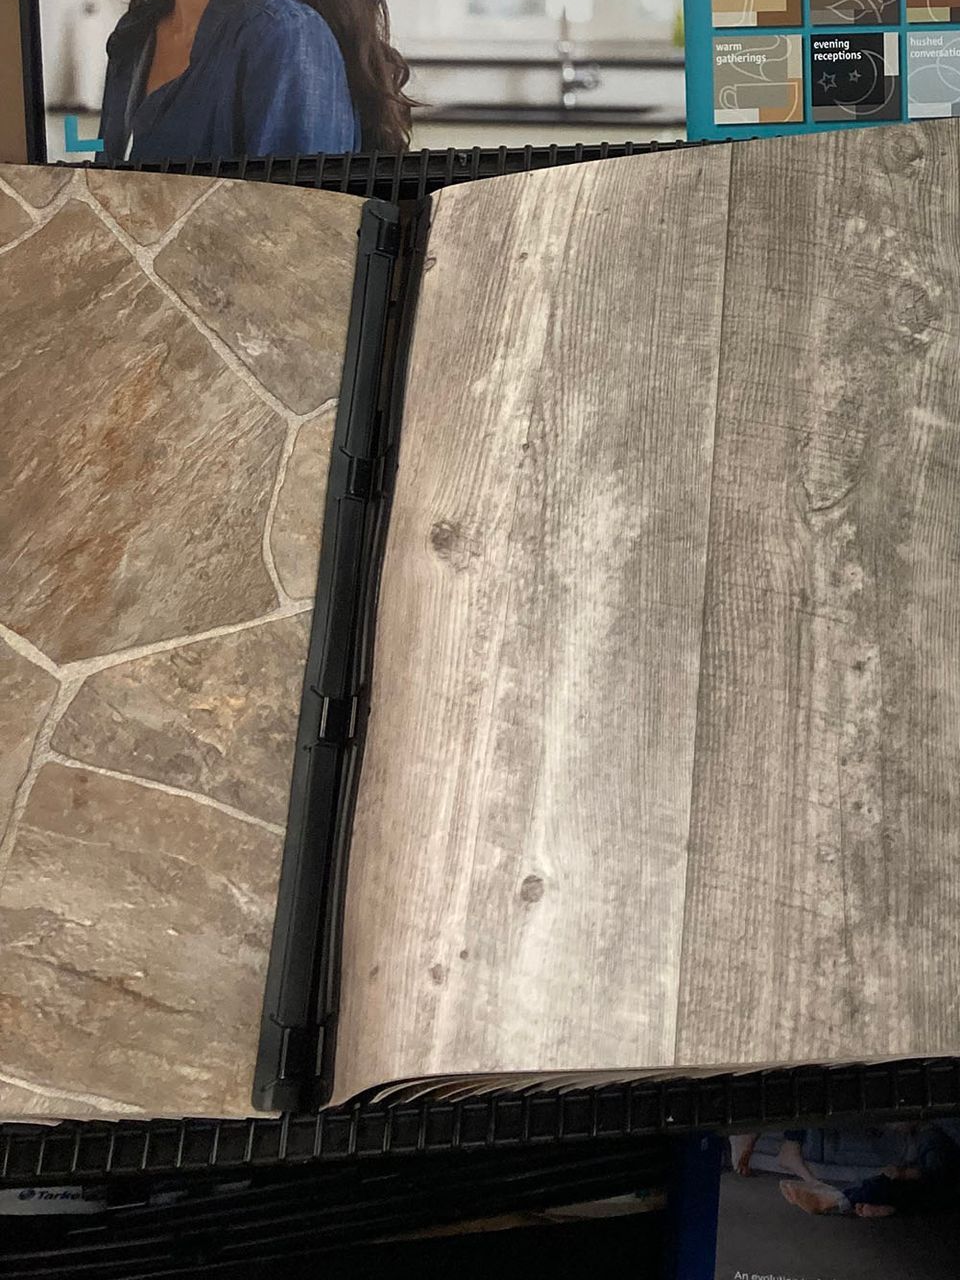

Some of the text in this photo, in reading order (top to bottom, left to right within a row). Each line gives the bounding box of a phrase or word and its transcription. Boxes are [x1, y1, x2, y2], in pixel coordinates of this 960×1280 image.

[814, 38, 850, 51] evening
[910, 36, 943, 46] hushed
[716, 43, 742, 52] warm
[716, 52, 767, 64] gatherings
[814, 49, 862, 62] receptions
